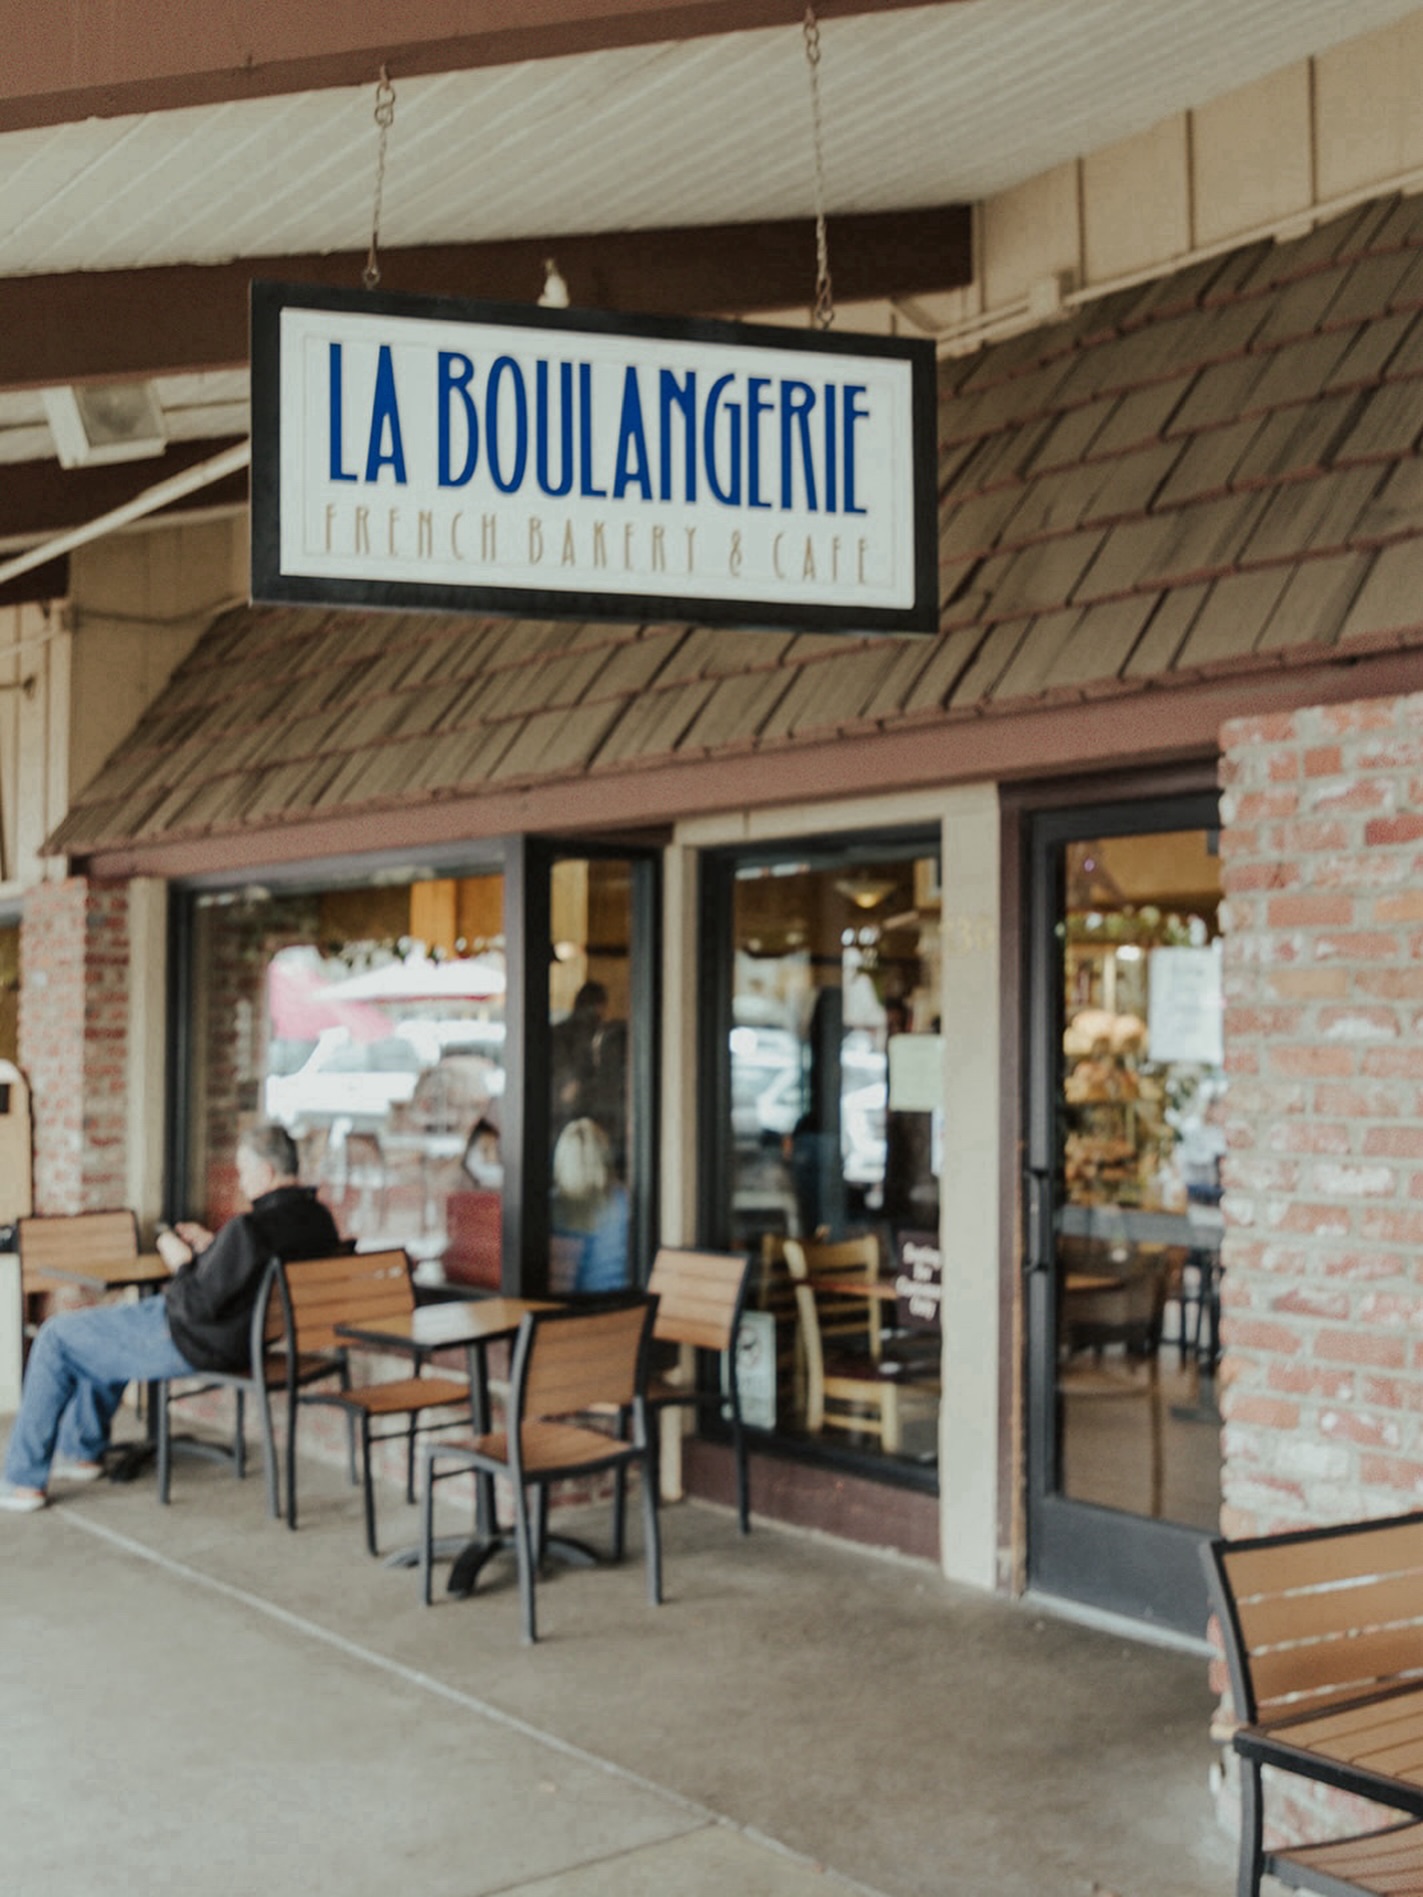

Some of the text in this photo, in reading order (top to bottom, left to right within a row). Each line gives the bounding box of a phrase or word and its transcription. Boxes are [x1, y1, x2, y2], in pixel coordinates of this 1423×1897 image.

[330, 344, 868, 513] LA BOULANGERIE
[325, 503, 869, 585] FRENCH BAKERY & CAFE
